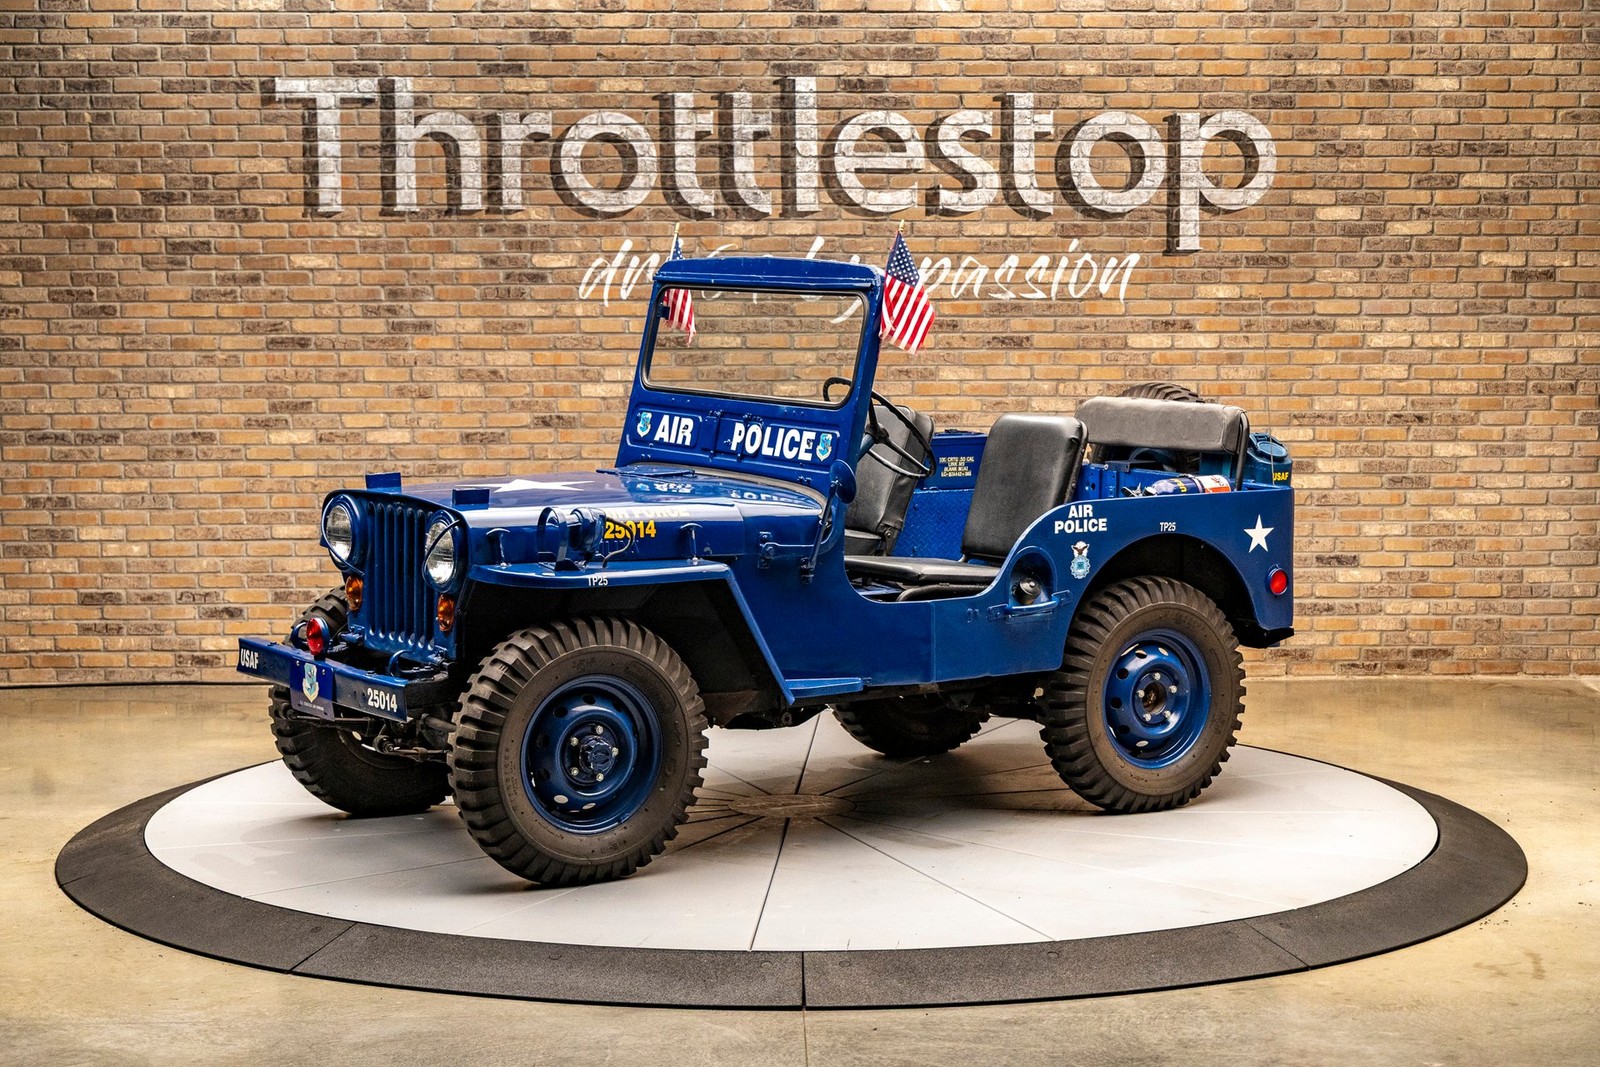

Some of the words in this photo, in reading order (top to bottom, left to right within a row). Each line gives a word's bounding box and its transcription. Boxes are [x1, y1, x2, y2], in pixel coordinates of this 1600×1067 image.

[268, 75, 1277, 254] Throttlestop
[916, 238, 1142, 304] passion
[654, 414, 694, 446] AIR
[730, 421, 817, 462] POLICE
[1272, 471, 1290, 481] USAF
[1067, 504, 1094, 519] AIR
[603, 520, 656, 539] 25014
[1054, 518, 1108, 534] POLICE
[1159, 521, 1177, 532] TP25
[587, 576, 609, 587] TP25
[240, 648, 259, 669] USAF
[366, 687, 398, 713] 25014
